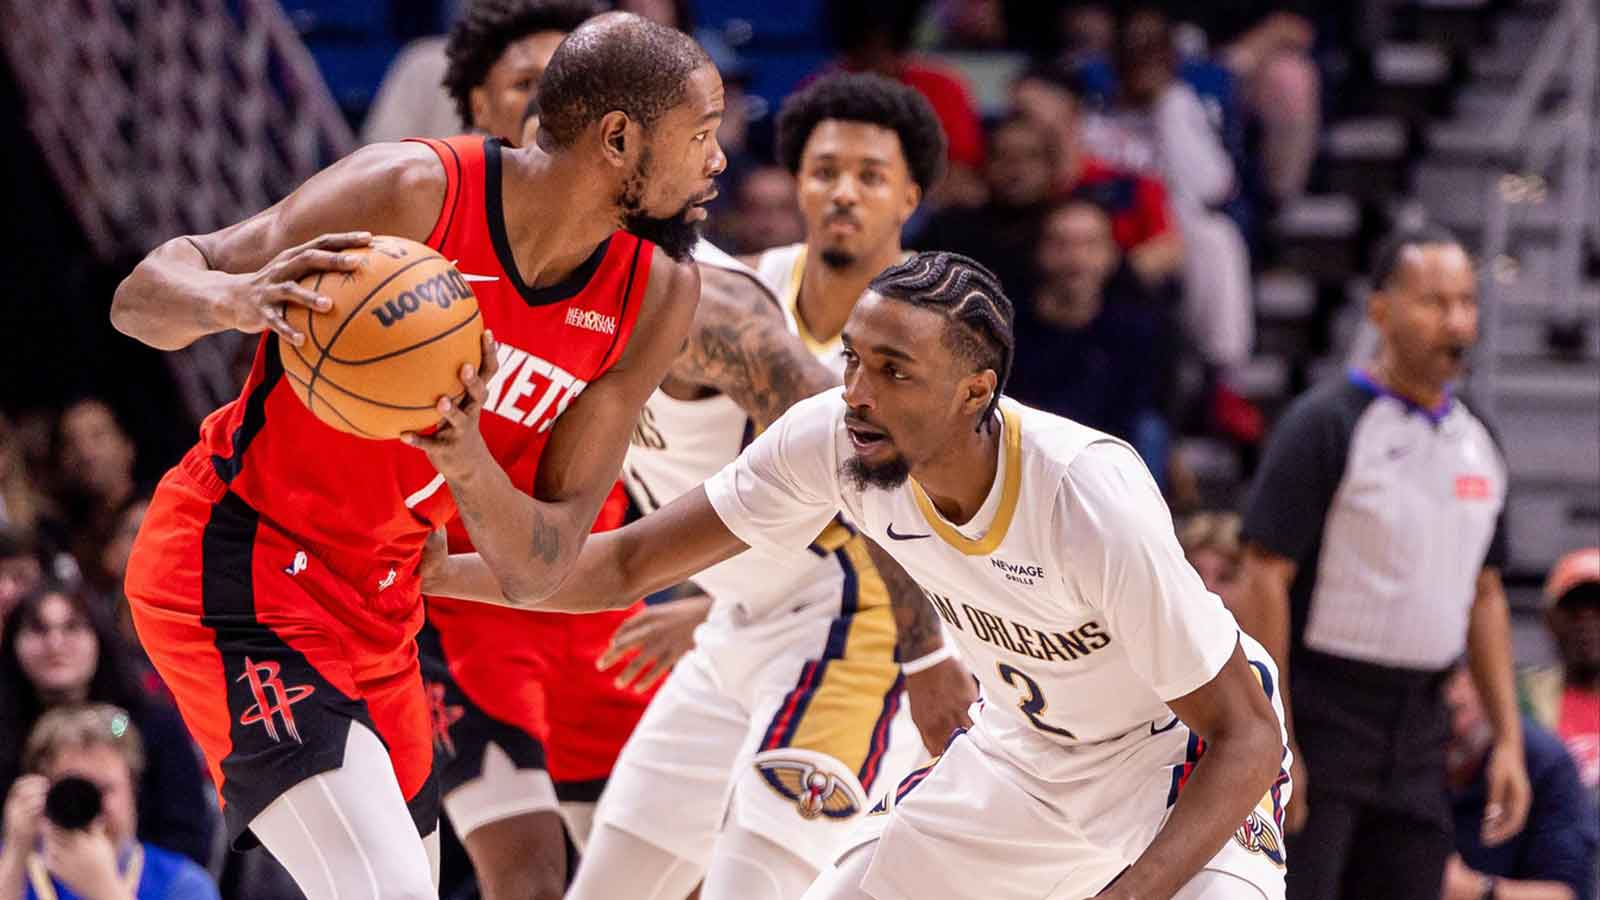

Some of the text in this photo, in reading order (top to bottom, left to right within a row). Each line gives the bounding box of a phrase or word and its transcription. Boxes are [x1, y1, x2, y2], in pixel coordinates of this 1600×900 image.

[481, 341, 587, 433] KETS
[962, 603, 1112, 662] ORLEANS
[995, 659, 1079, 741] 2
